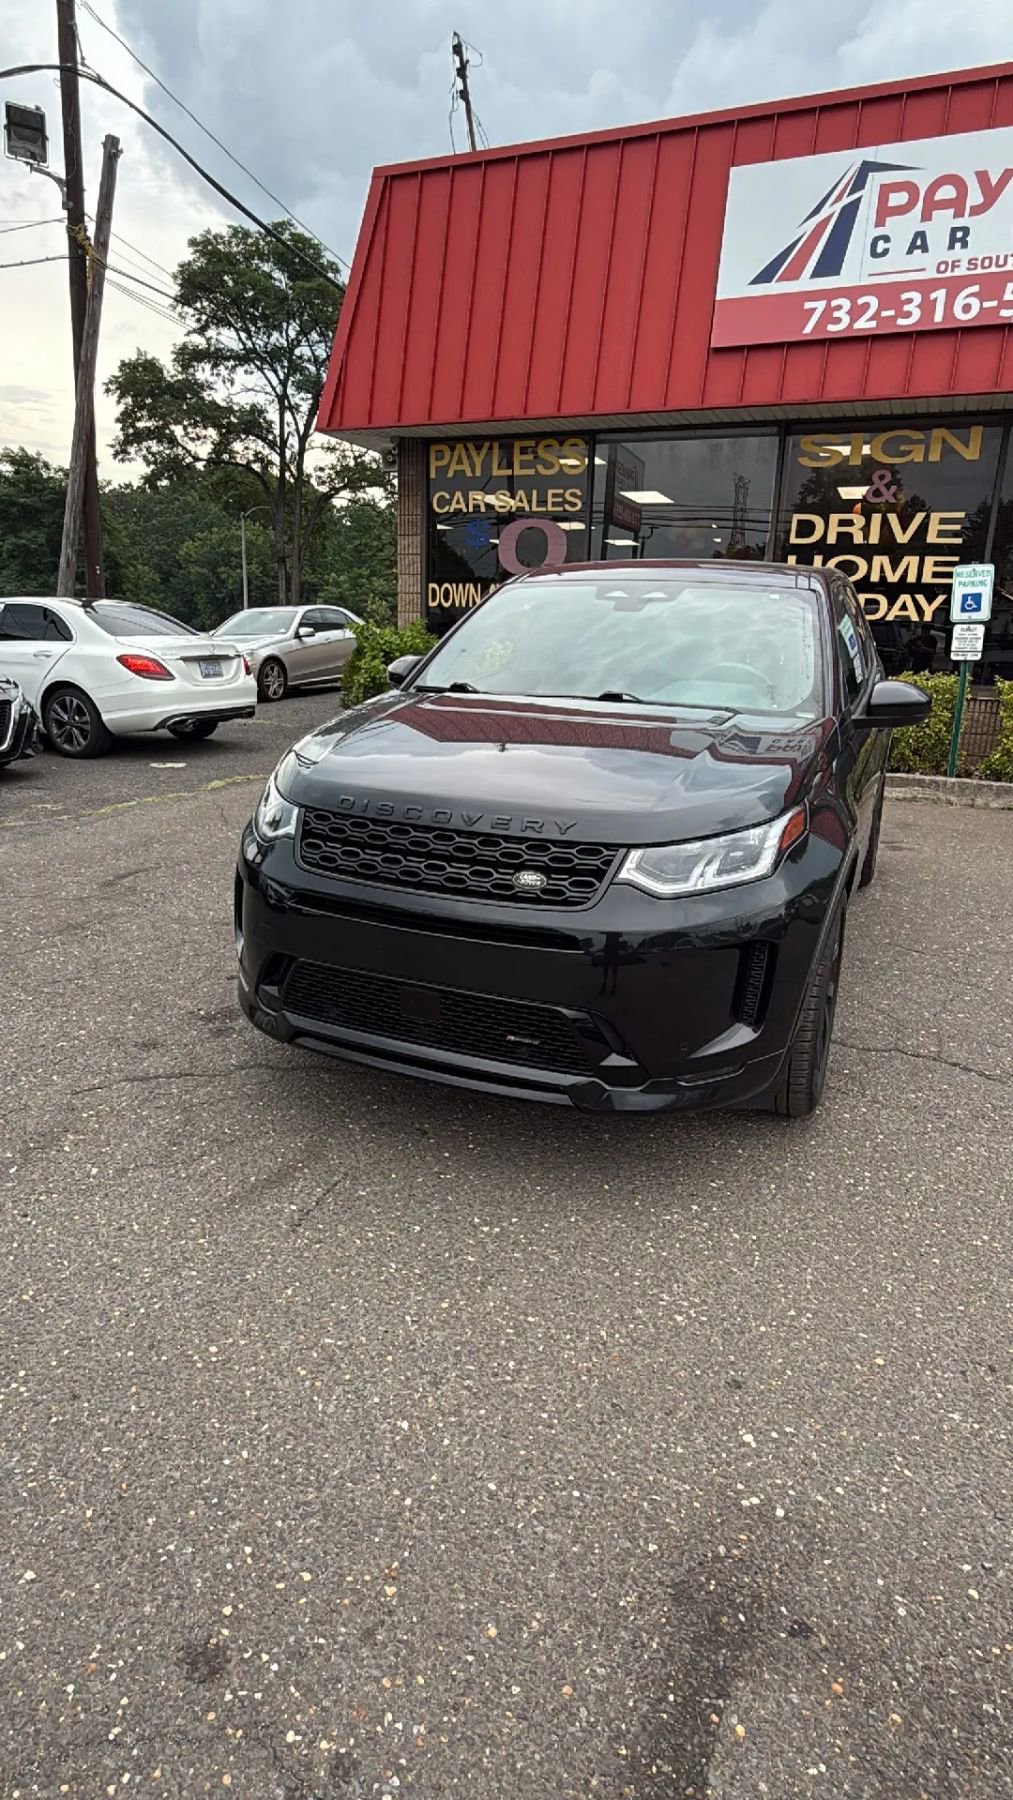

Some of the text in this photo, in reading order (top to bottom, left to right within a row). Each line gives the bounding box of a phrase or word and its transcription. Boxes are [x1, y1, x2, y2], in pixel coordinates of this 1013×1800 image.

[869, 226, 971, 260] CAR
[935, 259, 961, 275] OF
[429, 437, 588, 481] PAYLESS
[796, 425, 984, 468] SIGN
[432, 488, 583, 514] CAR SALES
[865, 469, 897, 504] &
[789, 511, 966, 545] DRIVE
[428, 582, 481, 608] DOWN
[958, 579, 988, 588] PARKING
[337, 794, 578, 835] DISCOVERY
